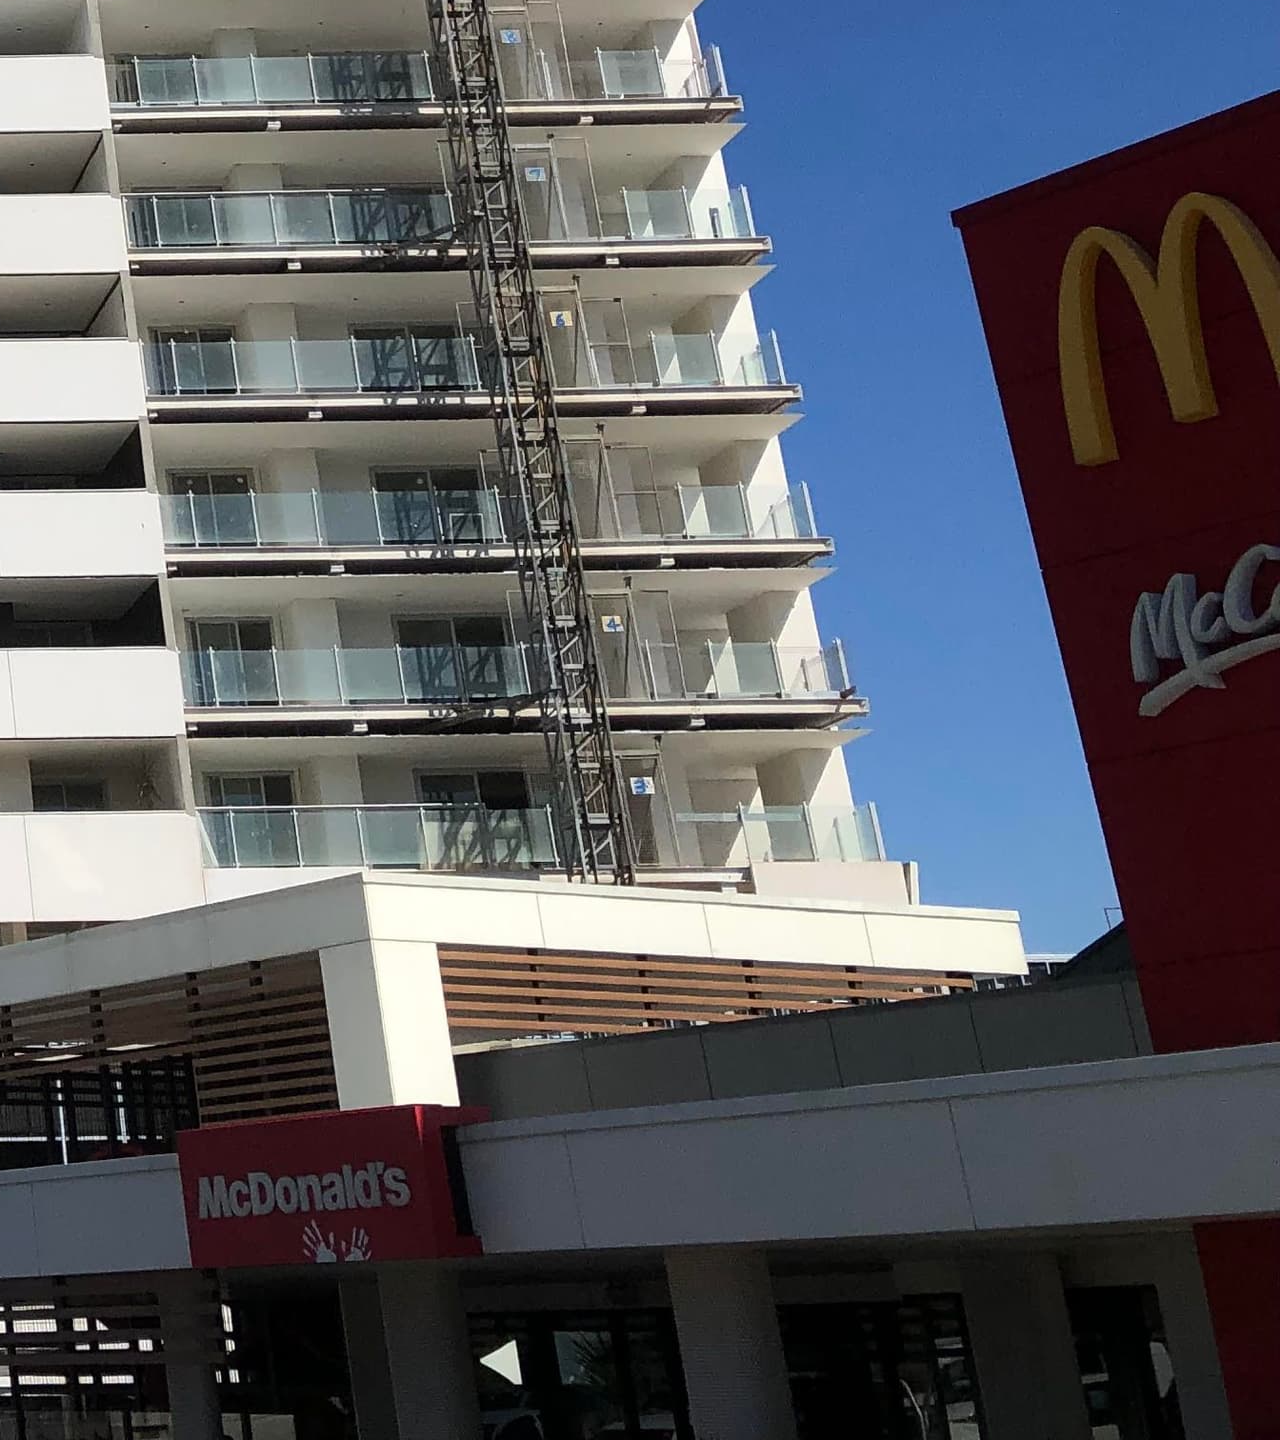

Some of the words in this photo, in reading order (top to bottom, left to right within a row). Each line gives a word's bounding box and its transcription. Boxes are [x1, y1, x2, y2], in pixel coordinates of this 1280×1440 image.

[607, 617, 621, 632] 4
[1130, 544, 1280, 688] McC
[198, 1161, 412, 1220] McDonald's
